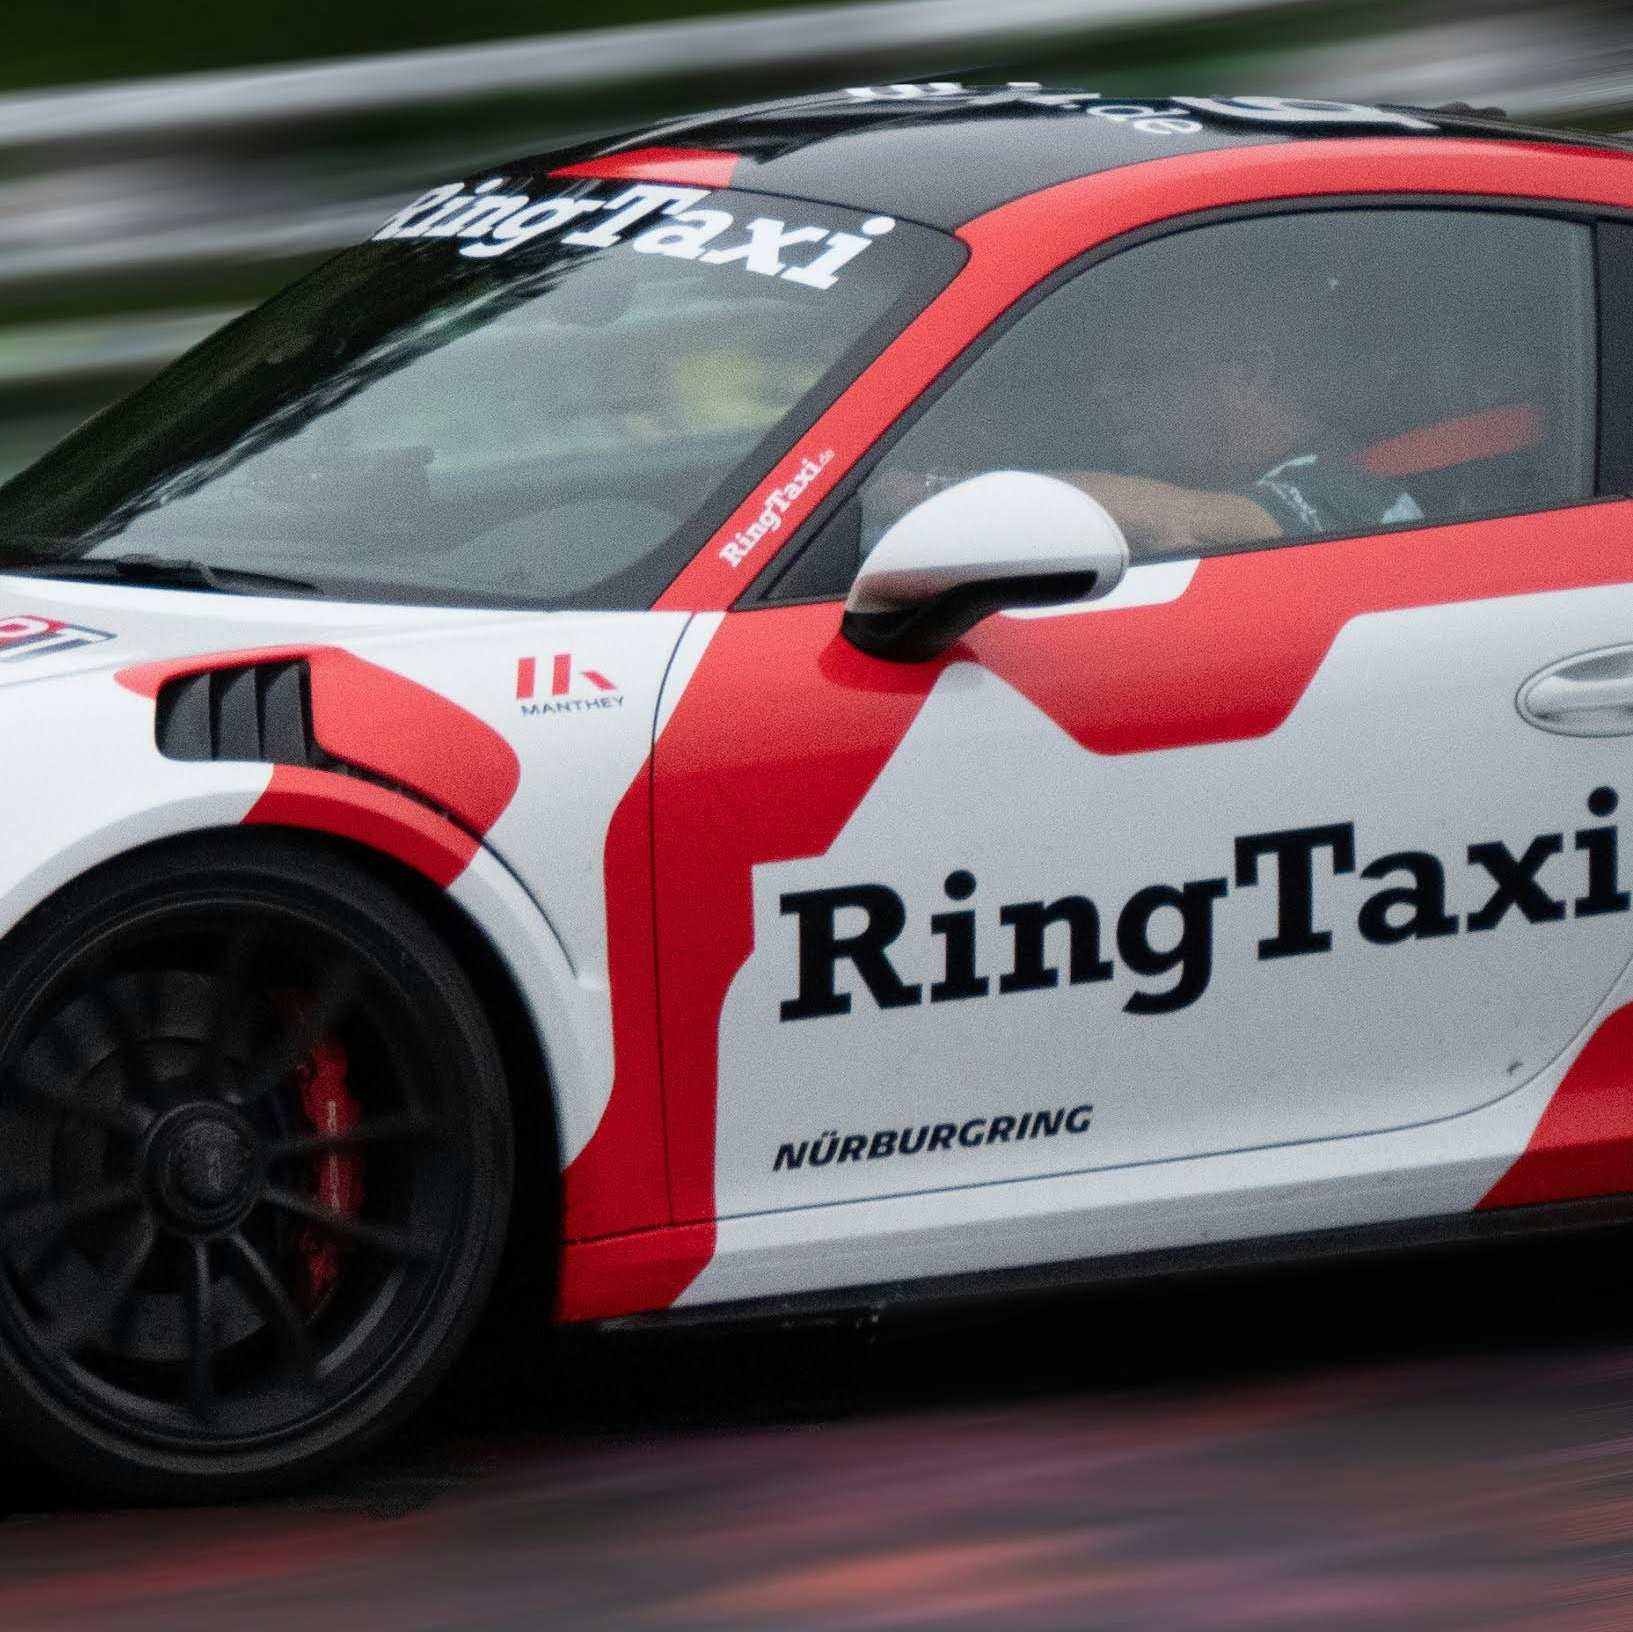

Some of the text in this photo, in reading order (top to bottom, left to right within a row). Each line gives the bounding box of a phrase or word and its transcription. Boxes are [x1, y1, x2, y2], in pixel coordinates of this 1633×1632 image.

[520, 695, 625, 716] MANTHEY
[779, 785, 1631, 1022] RingTaxi
[772, 1104, 1093, 1171] NÜRBURGRING
